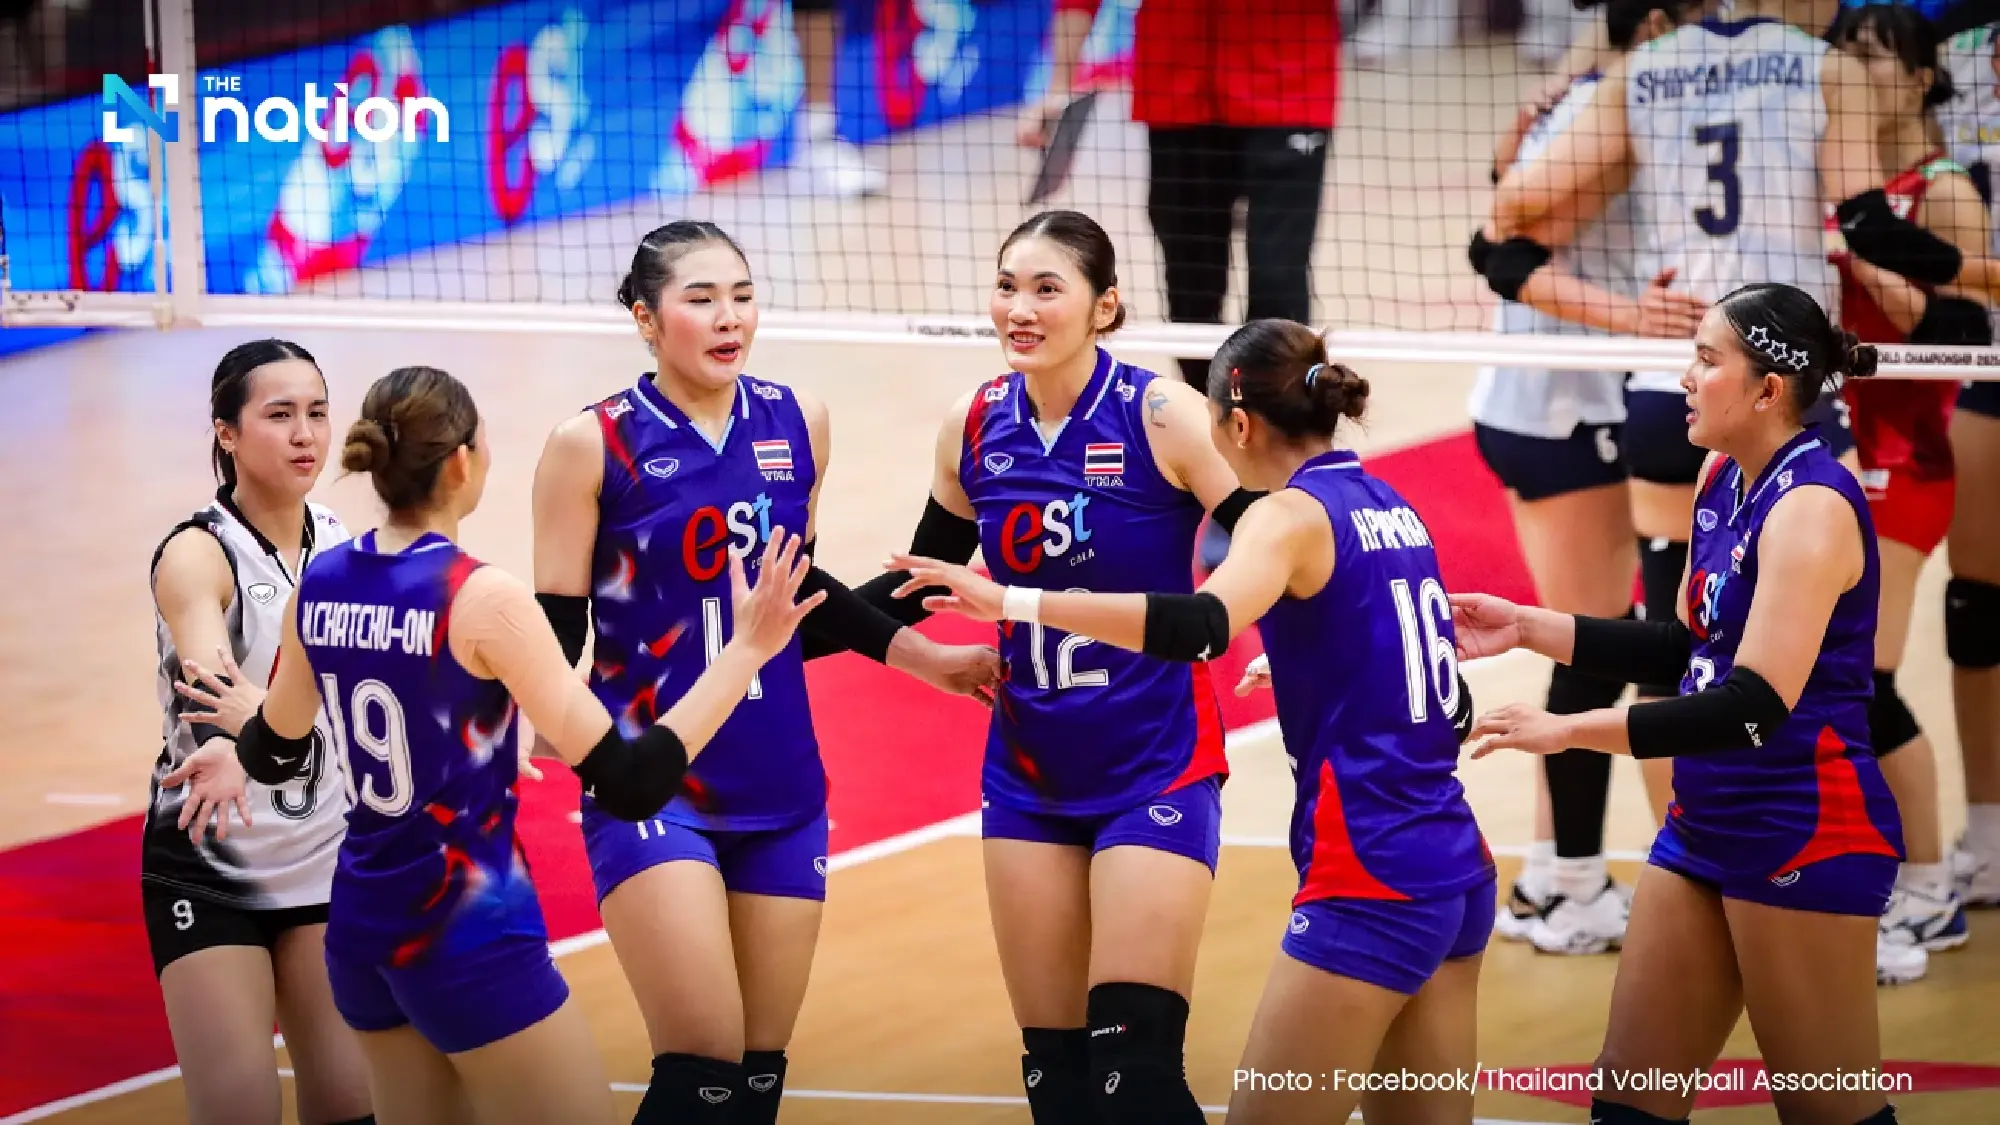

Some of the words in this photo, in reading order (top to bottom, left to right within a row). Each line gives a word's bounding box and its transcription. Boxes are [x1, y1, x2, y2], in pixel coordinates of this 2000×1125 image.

[1636, 54, 1804, 104] SHIMAMURA
[1692, 121, 1741, 238] 3
[1084, 475, 1124, 487] THA
[1594, 427, 1618, 463] 6
[682, 491, 774, 582] est
[1001, 491, 1093, 574] est
[1389, 577, 1460, 723] 16
[319, 672, 415, 817] 19
[172, 899, 195, 931] 9
